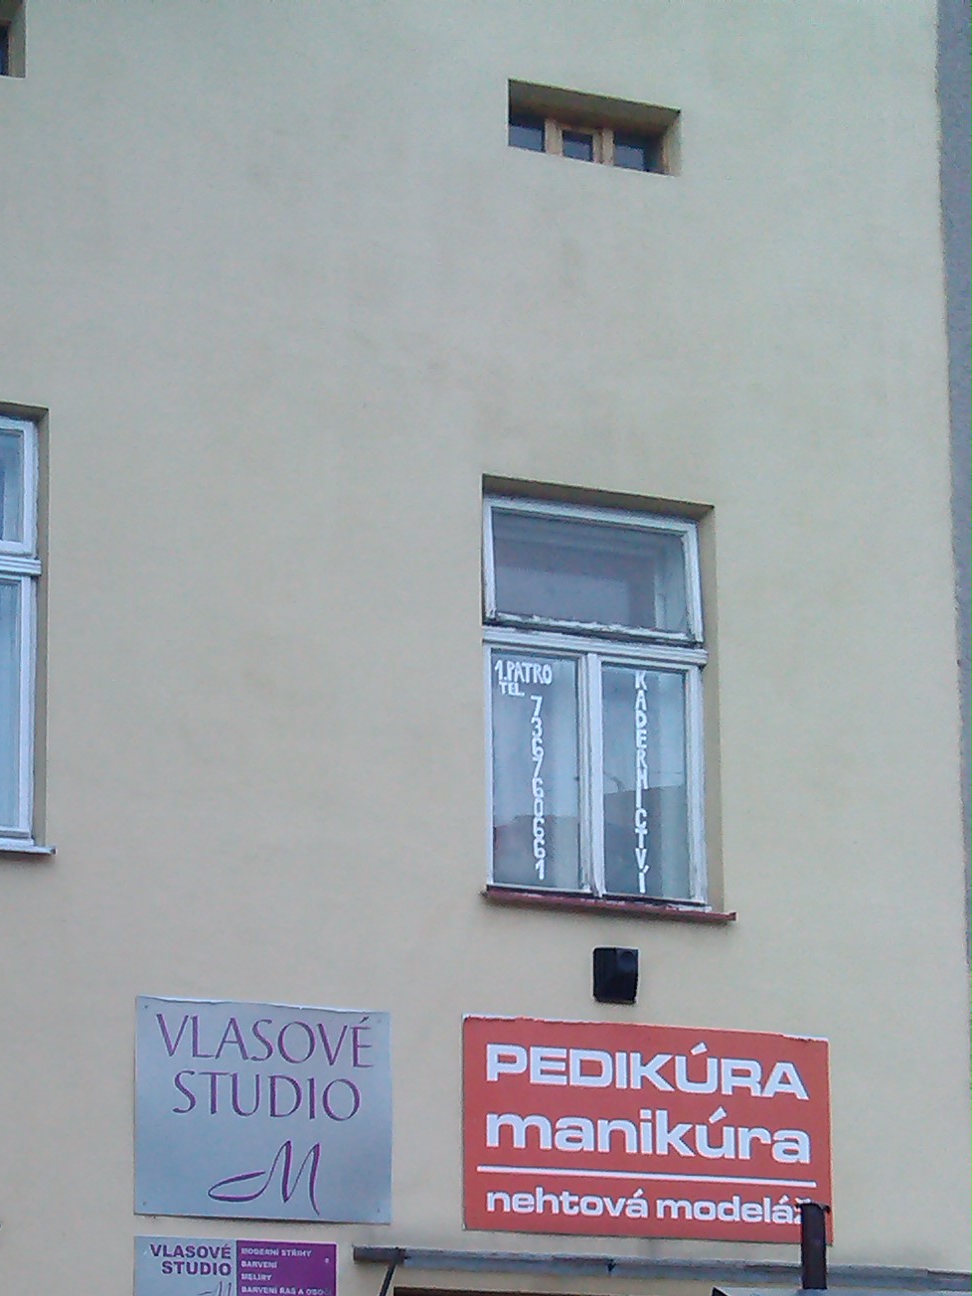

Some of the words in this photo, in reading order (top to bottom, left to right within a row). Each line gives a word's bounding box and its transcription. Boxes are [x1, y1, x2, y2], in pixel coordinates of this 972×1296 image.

[156, 1013, 374, 1068] VLASOVÉ
[173, 1070, 360, 1121] STUDIO
[486, 1042, 809, 1101] PEDIKÚRA
[486, 1106, 811, 1164] manikúra
[486, 1186, 648, 1219] nehtová
[150, 1243, 231, 1259] VLASOVÉ
[162, 1260, 232, 1276] STUDIO
